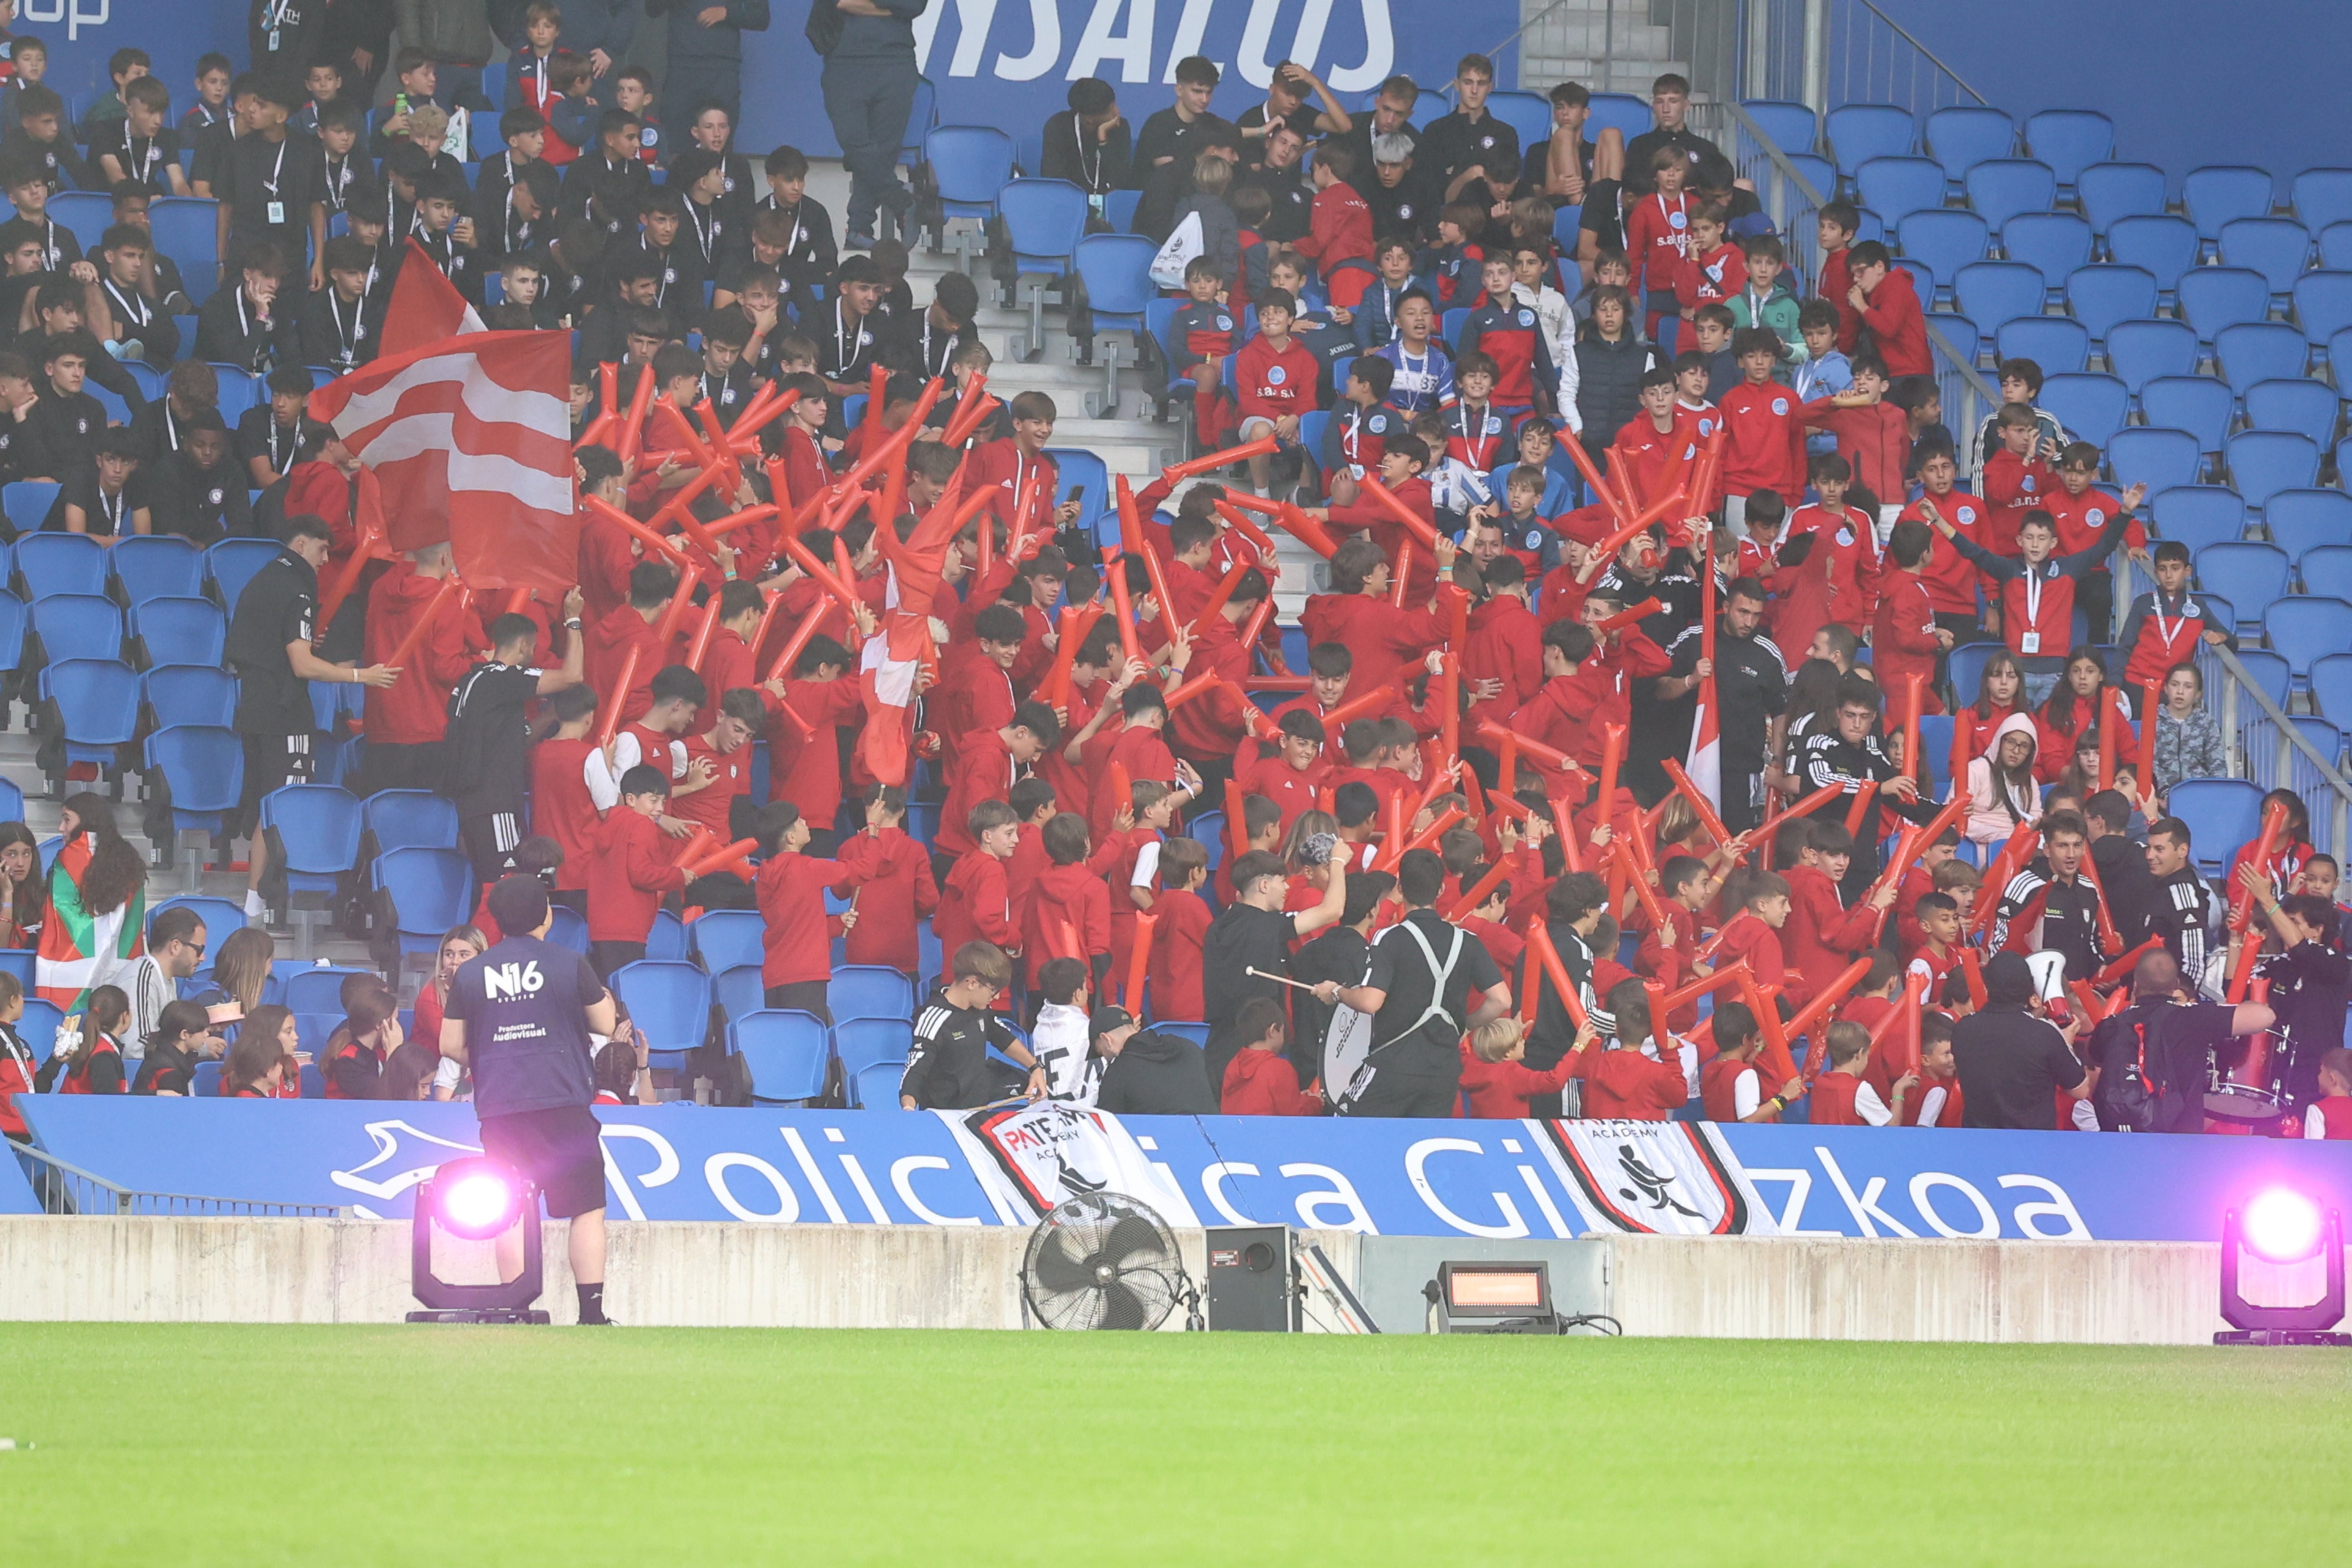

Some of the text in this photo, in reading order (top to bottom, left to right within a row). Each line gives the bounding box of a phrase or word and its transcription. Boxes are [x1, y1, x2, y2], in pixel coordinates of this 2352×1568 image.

[484, 961, 544, 999] N16
[493, 1027, 547, 1042] Audiovisual
[498, 1023, 535, 1033] Productora
[1592, 1128, 1658, 1139] ACADEMY
